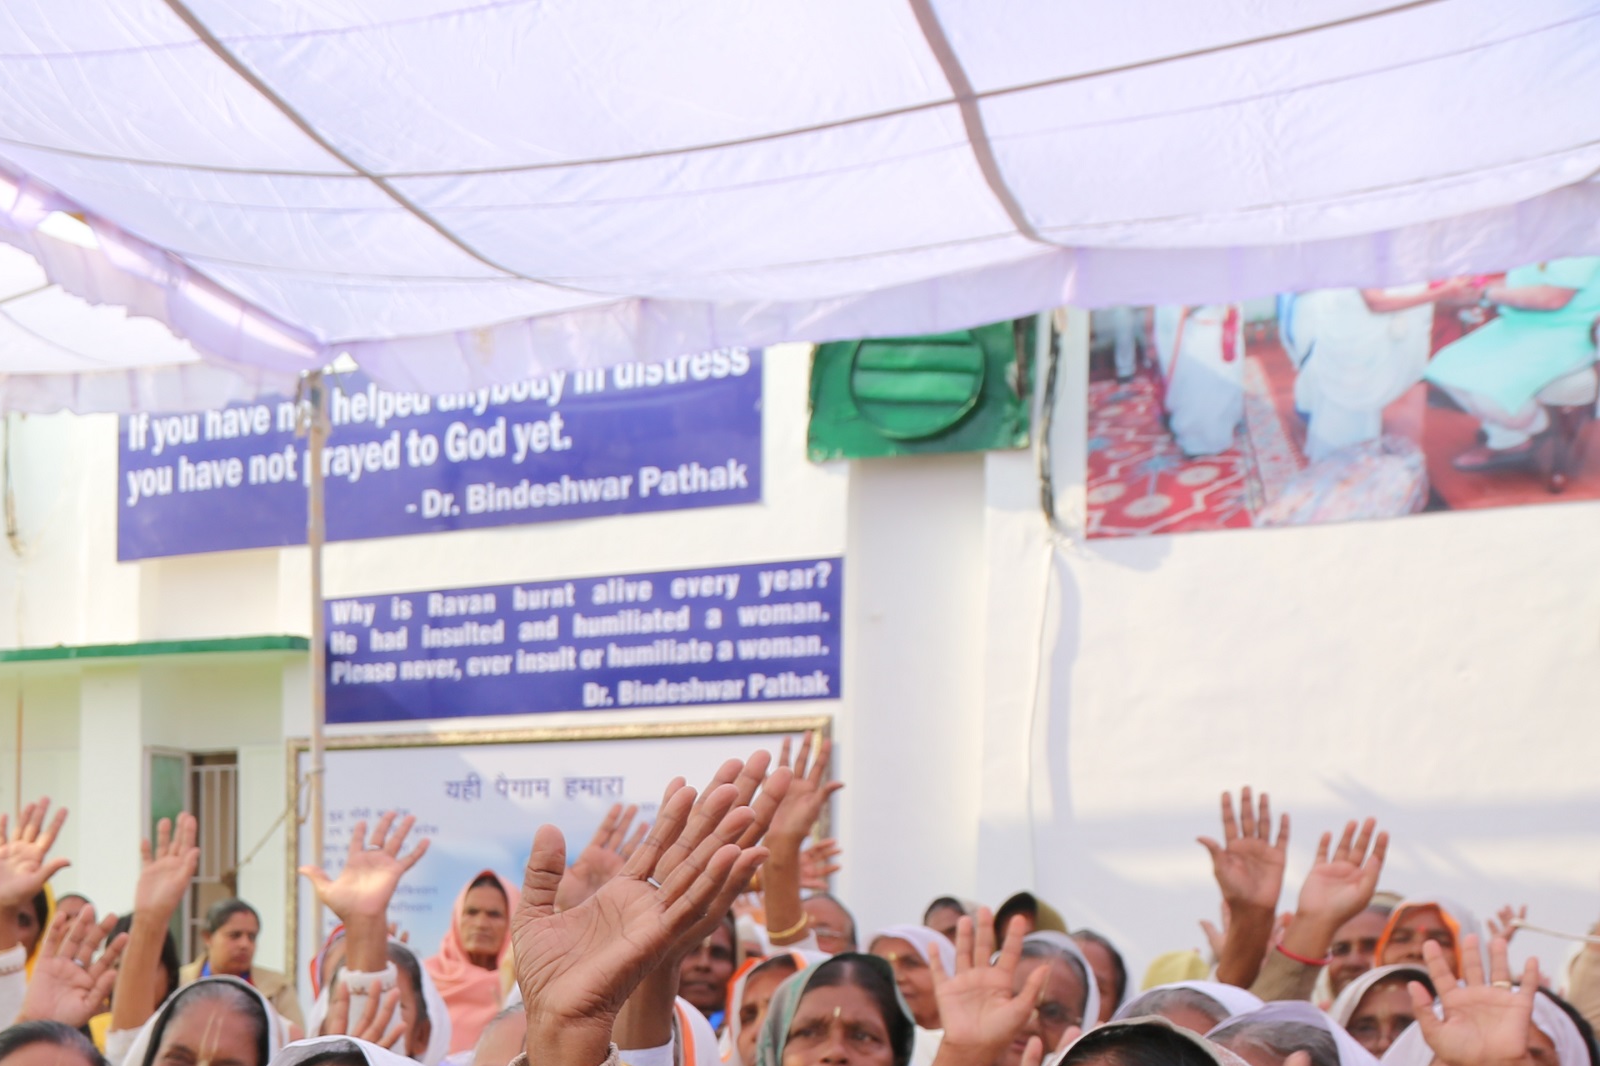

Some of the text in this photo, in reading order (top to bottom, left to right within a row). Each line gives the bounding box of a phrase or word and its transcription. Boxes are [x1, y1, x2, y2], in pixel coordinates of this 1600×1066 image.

[129, 413, 147, 450] If
[152, 412, 198, 456] you
[205, 401, 271, 441] have
[127, 466, 173, 507] you
[178, 455, 243, 492] have
[249, 444, 298, 484] not
[406, 429, 439, 468] to
[444, 416, 506, 463] God
[512, 411, 573, 465] yet.
[422, 488, 461, 519] Dr.
[466, 473, 633, 515] Bindeshwar
[639, 458, 748, 498] Pathak
[330, 561, 832, 628] Why is Ravan burnt alive every year?
[330, 601, 830, 655] He had insulted and humiliated a woman.
[331, 635, 830, 685] Please never, ever insult or humiliate a woman.
[583, 669, 830, 707] Dr. Bindeshwar Pathak
[445, 772, 481, 800] यही
[563, 776, 625, 799] हमारा
